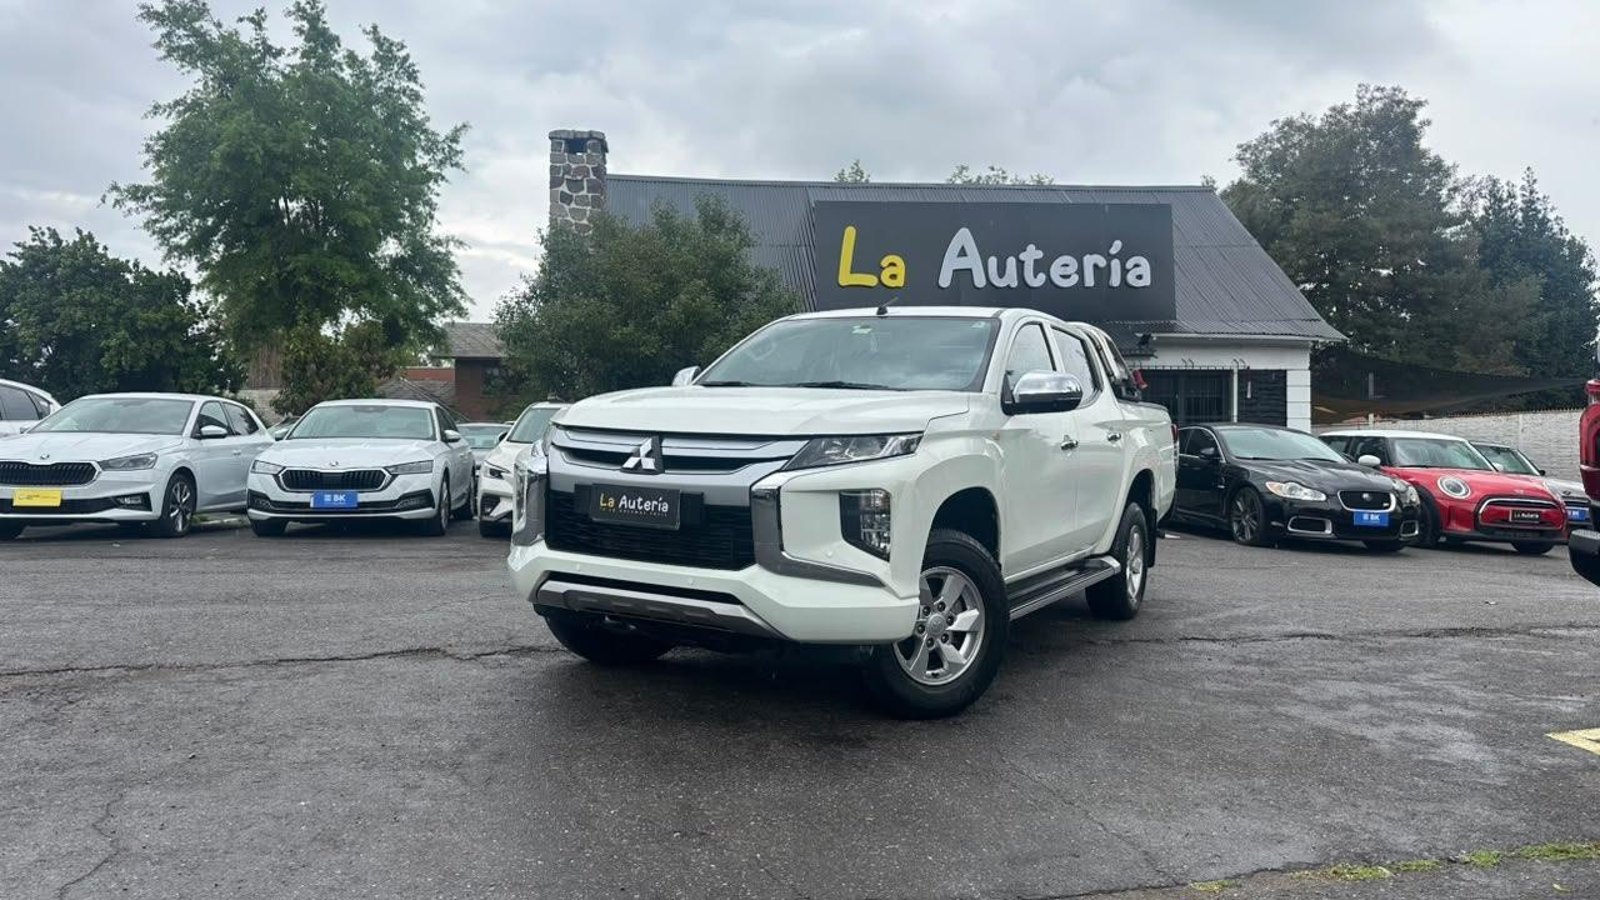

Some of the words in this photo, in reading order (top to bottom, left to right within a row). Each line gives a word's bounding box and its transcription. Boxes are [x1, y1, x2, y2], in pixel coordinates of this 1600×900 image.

[838, 225, 906, 288] La
[938, 227, 1151, 289] Autería
[600, 493, 615, 508] La
[619, 494, 669, 512] Autería
